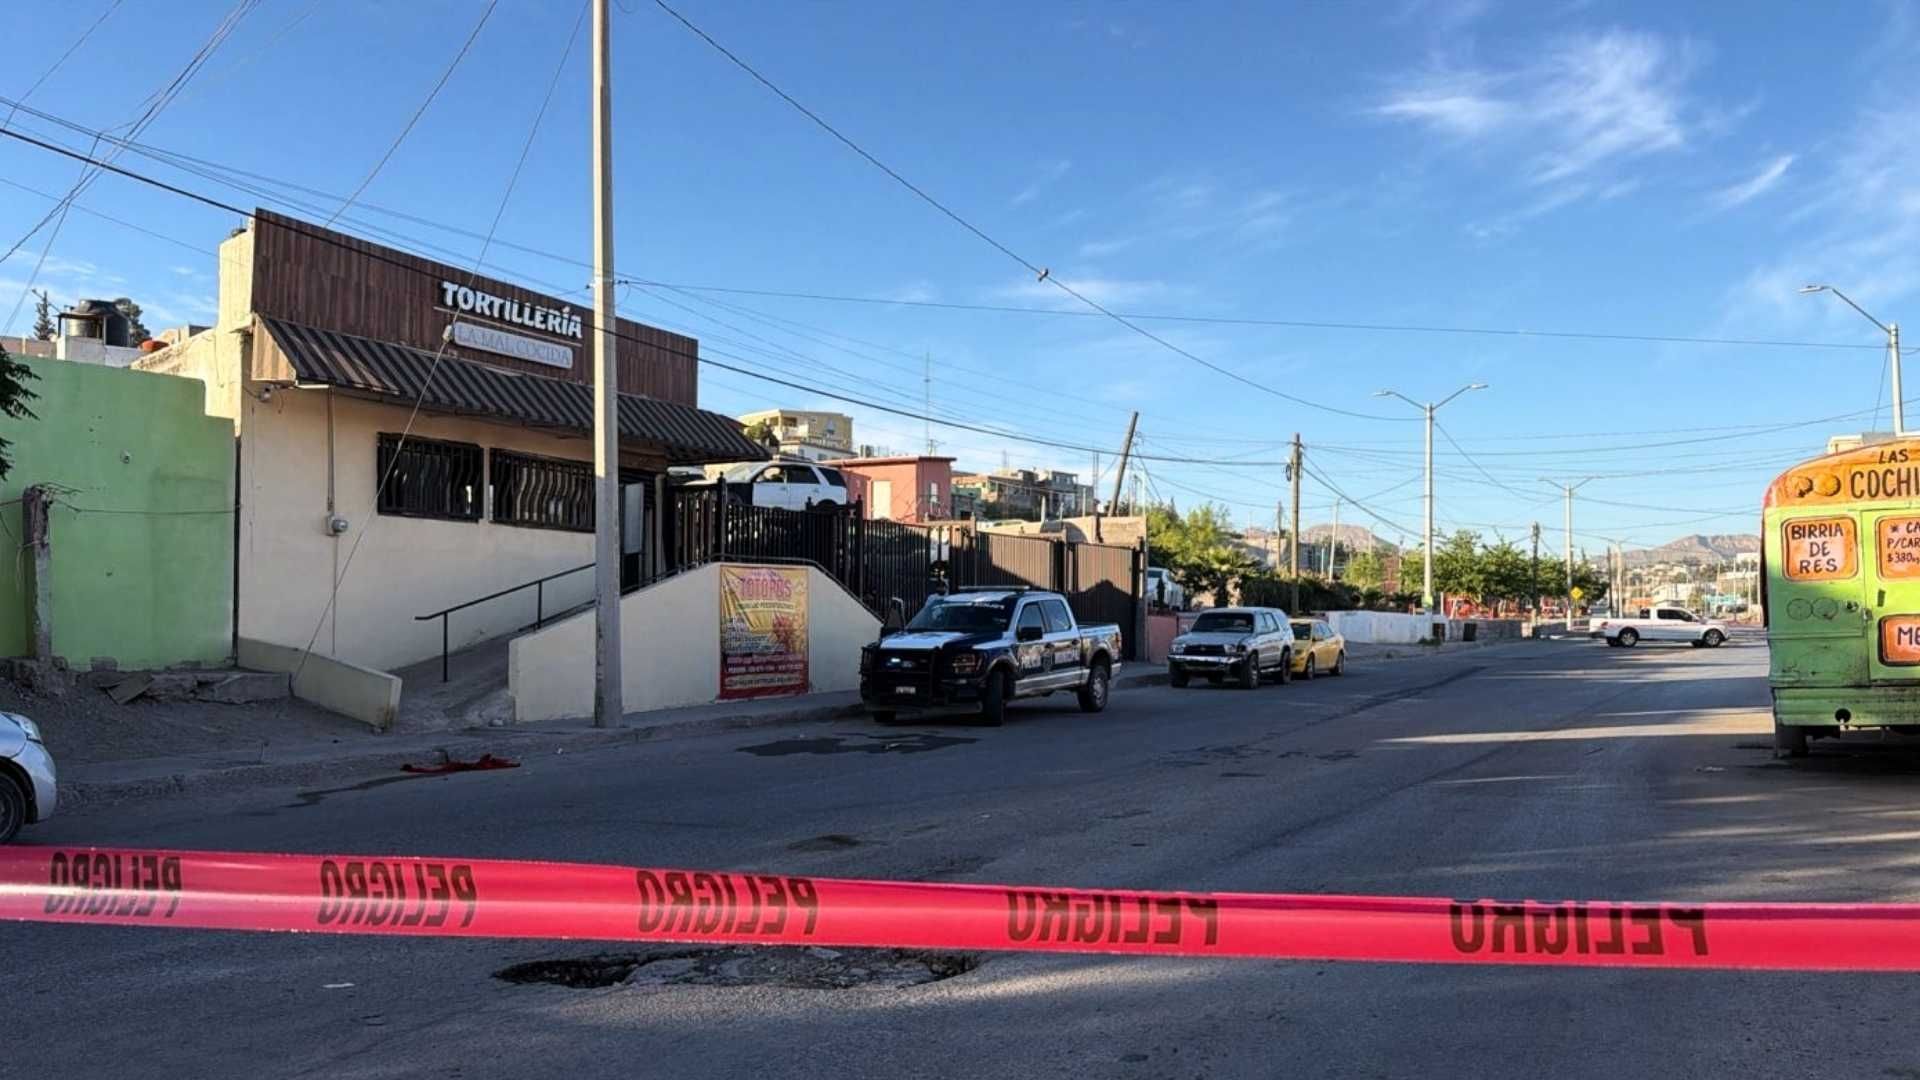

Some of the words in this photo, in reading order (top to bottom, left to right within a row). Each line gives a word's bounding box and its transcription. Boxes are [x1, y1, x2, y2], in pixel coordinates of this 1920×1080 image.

[442, 280, 583, 339] TORTILLERÍA
[1879, 449, 1909, 464] LAS
[1792, 522, 1844, 540] BIRRIA
[1809, 540, 1830, 557] DE
[1800, 559, 1838, 574] RES
[740, 577, 792, 598] TOTOPOS
